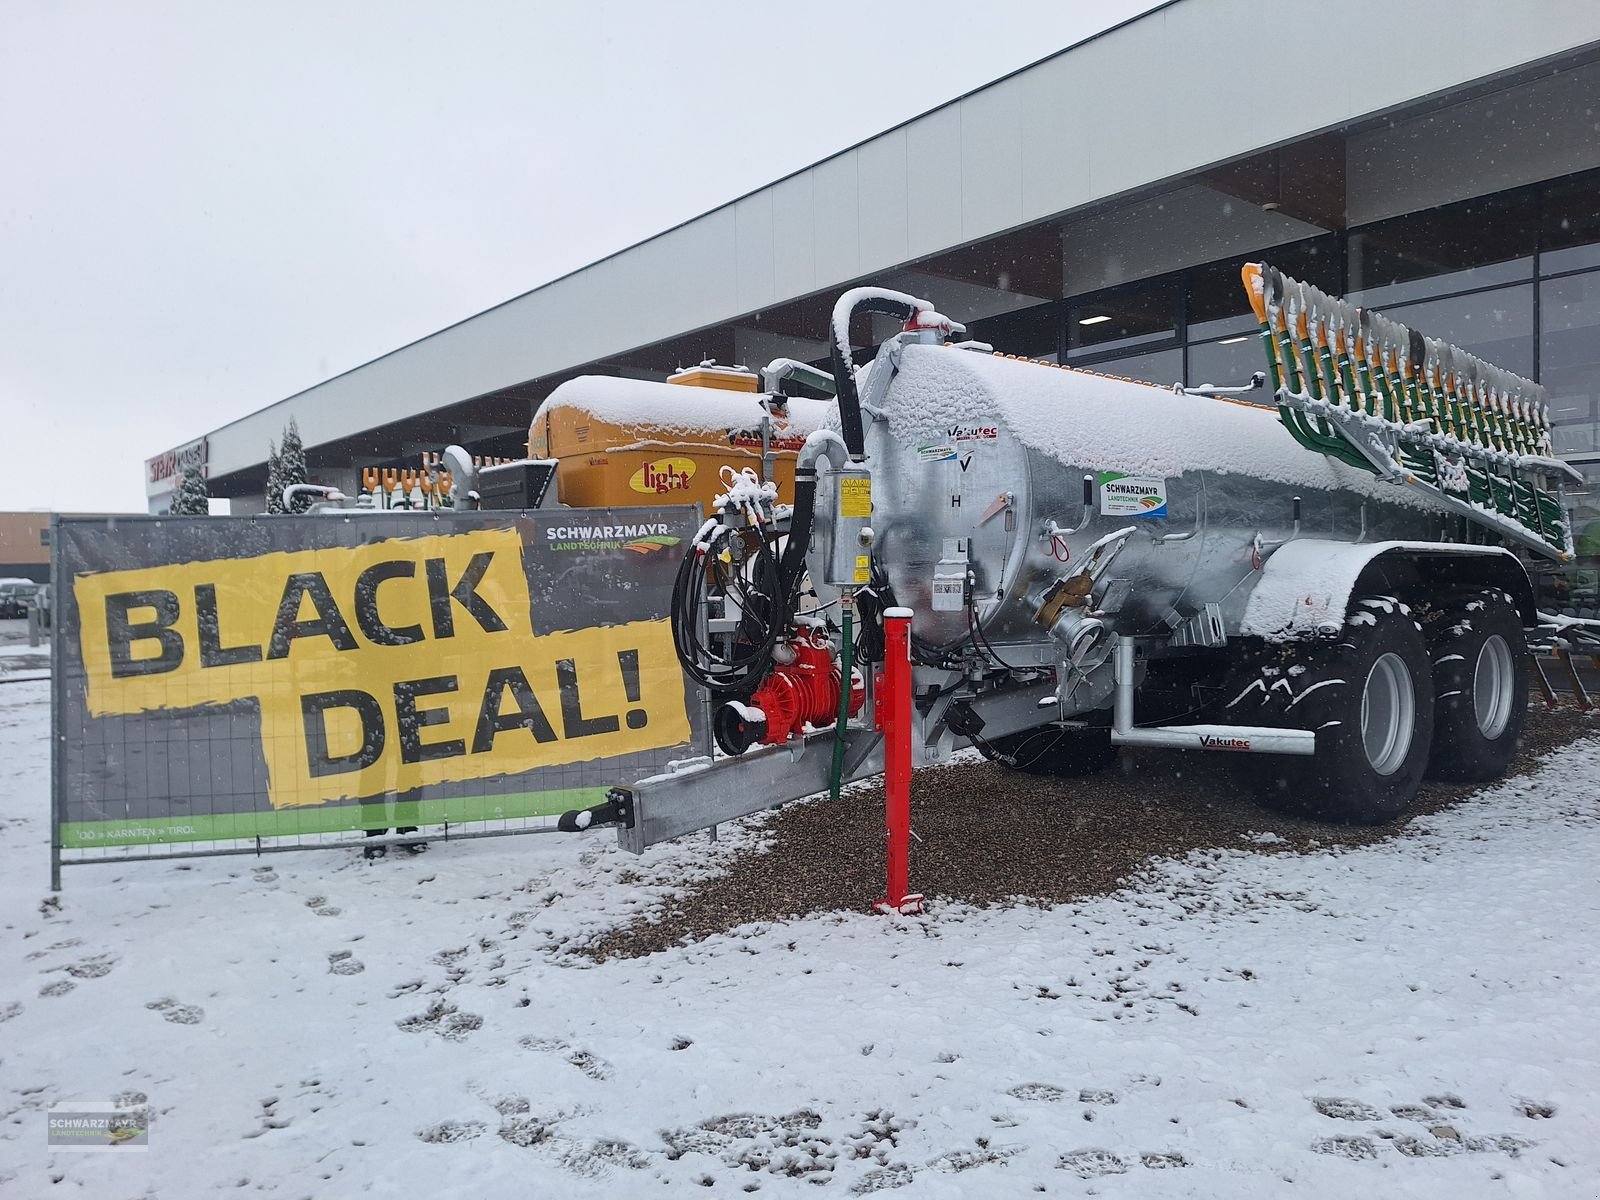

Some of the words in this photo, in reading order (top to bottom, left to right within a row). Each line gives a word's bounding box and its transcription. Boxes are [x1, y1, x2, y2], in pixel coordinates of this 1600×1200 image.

[643, 462, 689, 495] light
[1106, 483, 1158, 495] SCHWARZMAYR
[952, 495, 961, 507] H
[546, 523, 668, 540] SCHWARZMAYR
[958, 540, 966, 552] L
[104, 551, 509, 679] BLACK
[300, 649, 648, 778] DEAL!
[1199, 735, 1250, 747] Vakutec
